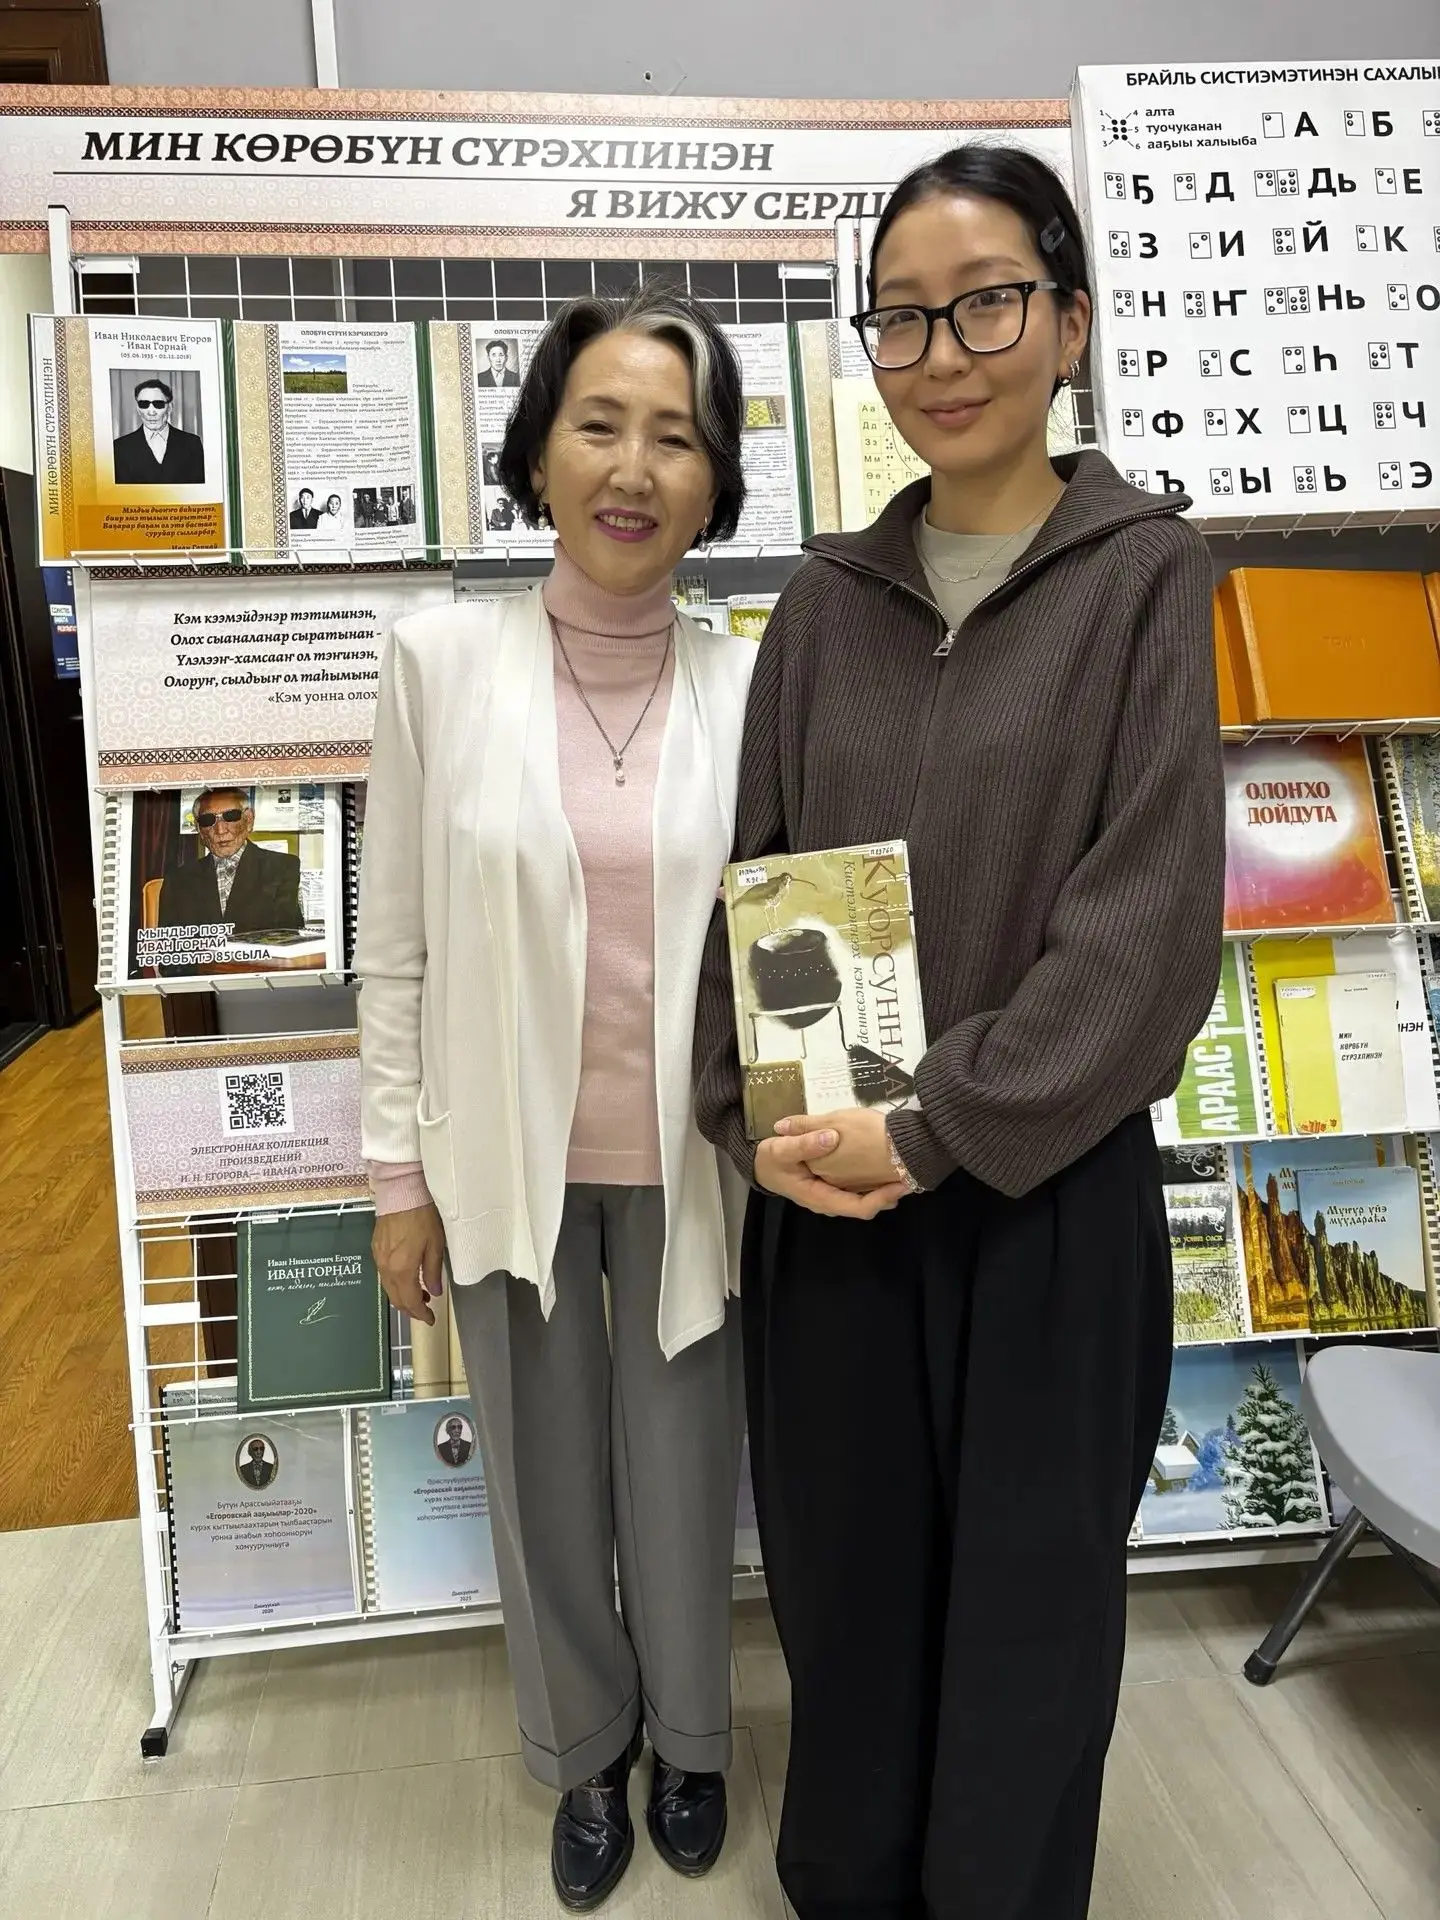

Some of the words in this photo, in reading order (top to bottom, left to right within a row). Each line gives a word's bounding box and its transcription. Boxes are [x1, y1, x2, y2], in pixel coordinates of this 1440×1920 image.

[1125, 67, 1197, 87] БРАЙЛЬ
[1200, 67, 1359, 86] СИСТИЭМЭТИНЭН
[1363, 65, 1440, 82] САХАЛЫ
[1145, 107, 1176, 118] алта
[1294, 111, 1319, 137] А
[1372, 111, 1394, 137] Б
[1145, 122, 1223, 135] туочуканан
[1196, 135, 1258, 148] халыыба
[80, 130, 204, 162] МИН
[210, 132, 444, 166] КӨРӨБҮН
[451, 136, 775, 172] СҮРЭХПИНЭН
[1205, 171, 1235, 203] Д
[1307, 167, 1358, 198] Дь
[1403, 167, 1423, 195] Е
[565, 189, 598, 219] Я
[608, 190, 751, 221] ВИЖУ
[1139, 232, 1159, 259] З
[1219, 230, 1245, 258] И
[1302, 219, 1329, 253] Й
[1383, 225, 1409, 253] К
[1141, 290, 1167, 317] Н
[1317, 283, 1366, 312] Нь
[1416, 284, 1440, 311] О
[94, 331, 119, 341] Иван
[120, 332, 179, 343] Николаевич
[180, 334, 212, 345] Егоров
[127, 341, 151, 350] Иван
[153, 342, 187, 352] Горнай
[1146, 349, 1168, 377] Р
[1229, 349, 1252, 376] С
[1396, 342, 1419, 369] Т
[42, 357, 56, 433] СҮРЭХПИНЭН
[1151, 409, 1184, 438] Ф
[1235, 407, 1262, 435] Х
[1318, 403, 1348, 435] Ц
[1402, 401, 1426, 428] Ч
[46, 435, 58, 486] КӨРӨБҮН
[1155, 469, 1186, 495] Ъ
[1239, 466, 1272, 494] Ы
[1323, 465, 1347, 492] Ь
[1409, 461, 1433, 489] Э
[49, 488, 59, 516] МИН
[173, 612, 202, 626] Кэм
[204, 609, 288, 626] кээмэйдэнэр
[290, 609, 377, 621] тэтиминэн,
[170, 633, 205, 647] Олох
[206, 631, 290, 646] сыаналанар
[291, 628, 374, 644] сыратынан
[296, 652, 313, 662] ол
[283, 673, 299, 683] ол
[267, 691, 302, 704] «Кэм
[304, 691, 345, 705] уонна
[347, 689, 378, 700] олох
[1247, 803, 1338, 827] ДОЙДУТА
[137, 925, 198, 941] МЫНДЫР
[199, 923, 235, 938] ПОЭТ
[137, 940, 176, 953] ИВАН
[176, 935, 227, 951] ГОРНАЙ
[216, 951, 233, 962] 85
[233, 948, 271, 961] СЫЛА
[853, 967, 870, 1045] кэпсээннэр
[190, 1141, 265, 1156] ЭЛЕКТРОННАЯ
[266, 1136, 330, 1150] КОЛЛЕКЦИЯ
[219, 1151, 302, 1167] ПРОИЗВЕДЕНИЙ
[180, 1175, 191, 1184] И.
[192, 1173, 204, 1183] Н.
[205, 1169, 250, 1182] ЕГОРОВА
[262, 1166, 297, 1178] ИВАНА
[299, 1162, 344, 1175] ГОРНОГО
[267, 1259, 288, 1267] Иван
[288, 1257, 334, 1266] Николаевич
[335, 1254, 362, 1264] Егоров
[267, 1267, 305, 1281] ИВАН
[307, 1261, 363, 1278] ГОРНАЙ
[210, 1534, 233, 1542] уонна
